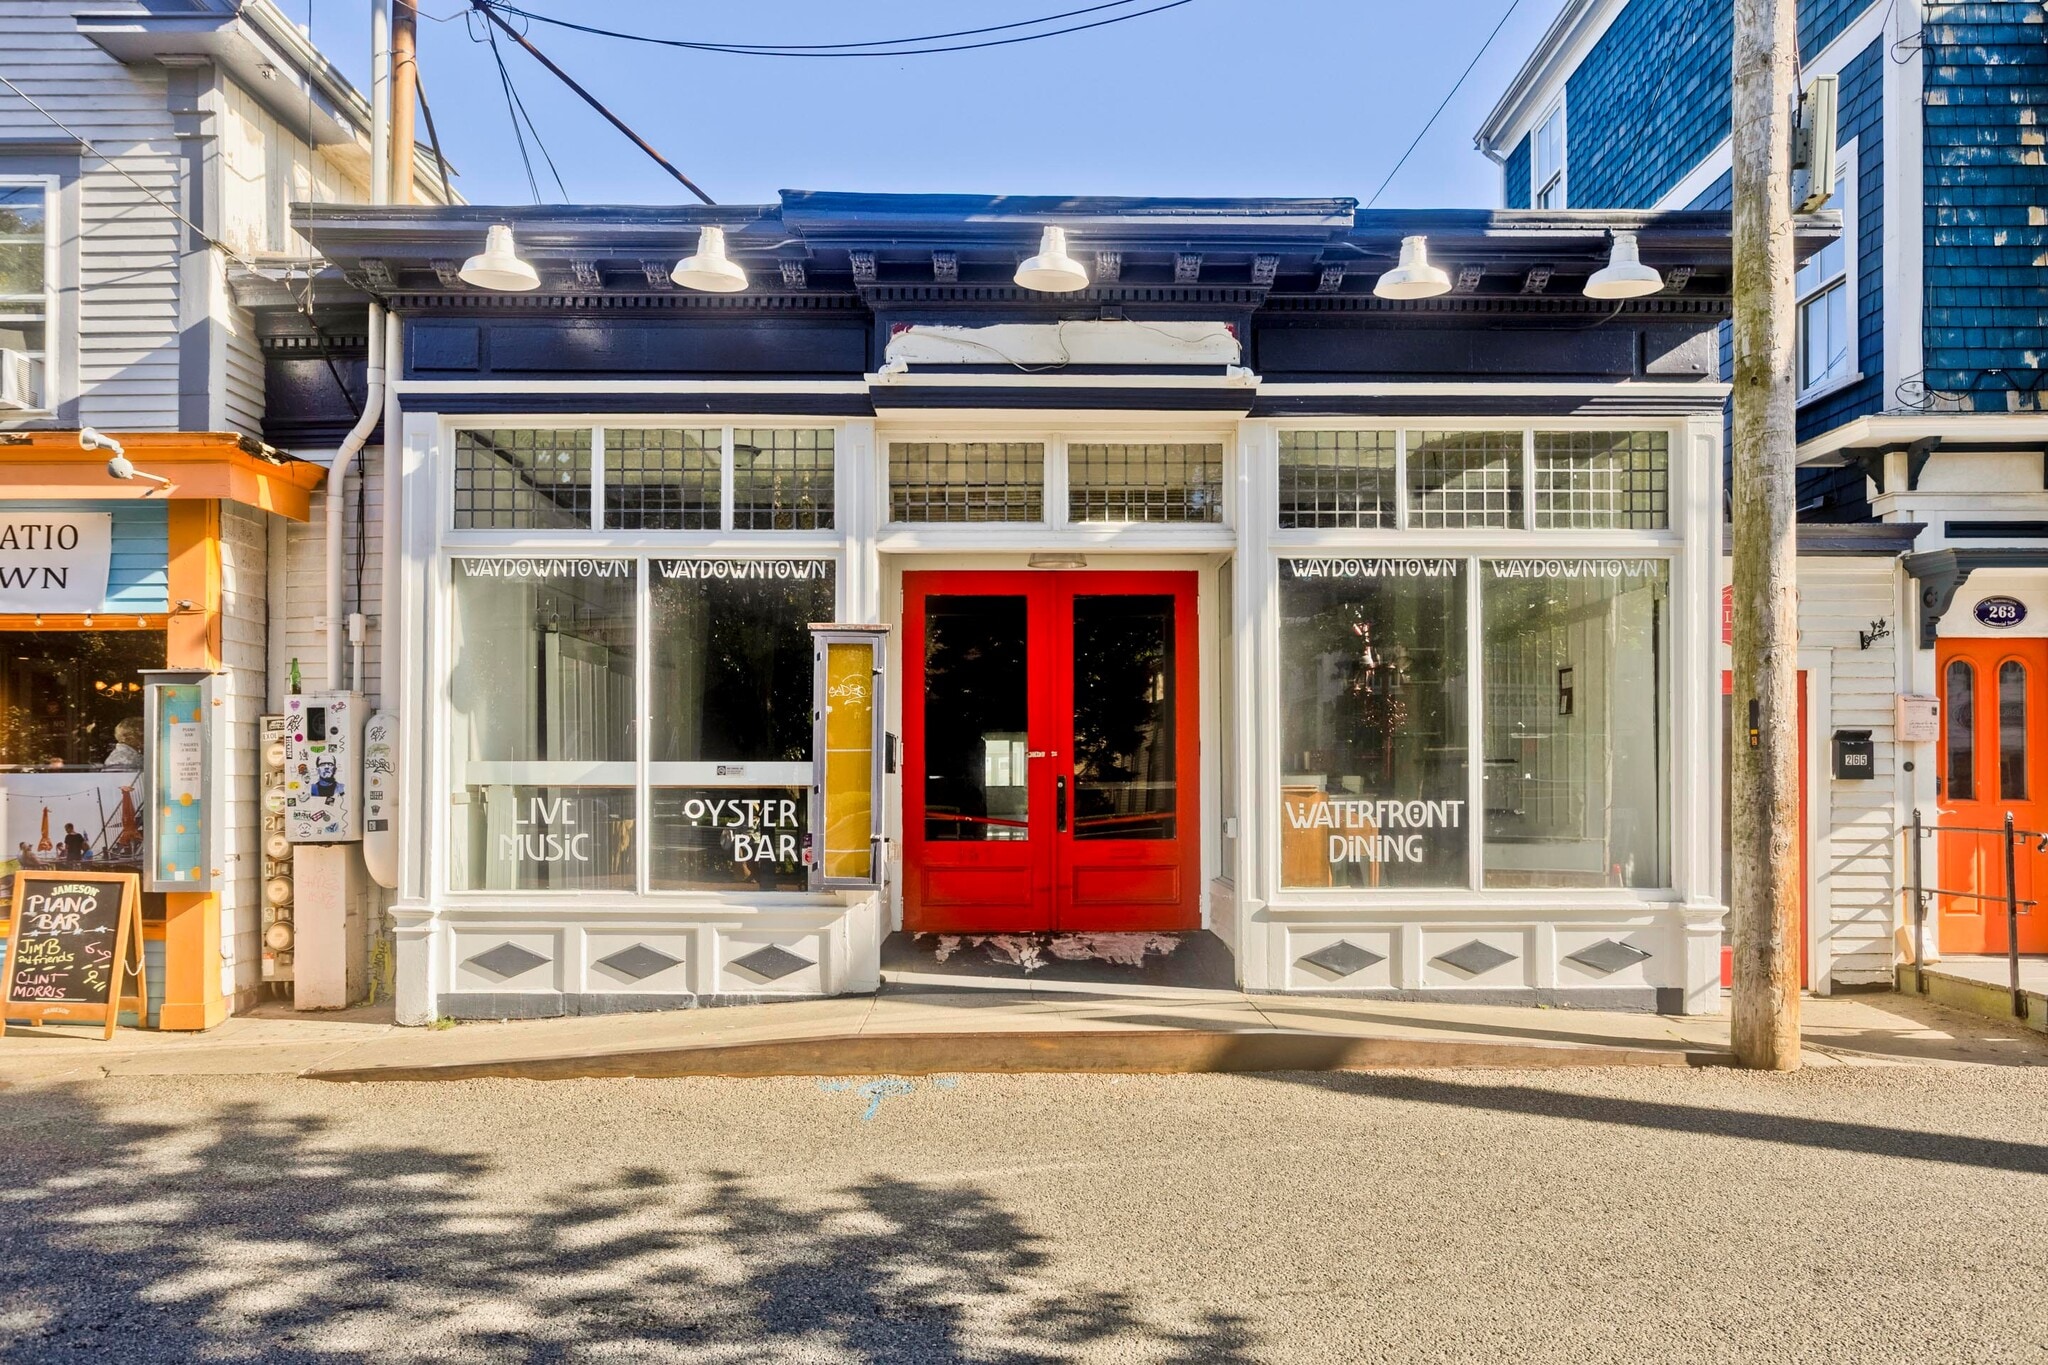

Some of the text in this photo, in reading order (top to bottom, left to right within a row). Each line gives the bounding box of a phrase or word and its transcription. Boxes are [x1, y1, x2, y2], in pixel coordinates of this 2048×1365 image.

[461, 559, 628, 577] WAYDOWNTOWN
[658, 560, 826, 578] WAYDOWNTOWN
[1289, 559, 1457, 577] WAYDOWNTOWN
[1491, 560, 1658, 577] WAYDOWNTOWN
[1989, 605, 2016, 618] 263
[1845, 755, 1867, 765] 265
[512, 797, 575, 824] LIVE
[684, 799, 799, 827] OYSTER
[1285, 800, 1465, 828] WATERFRONT
[265, 817, 274, 831] 2
[734, 834, 799, 862] BAR
[51, 884, 100, 897] JAMESON
[23, 894, 98, 916] PIANO
[29, 913, 80, 931] BAR
[16, 971, 69, 985] CLINT
[13, 986, 66, 999] MORRIS
